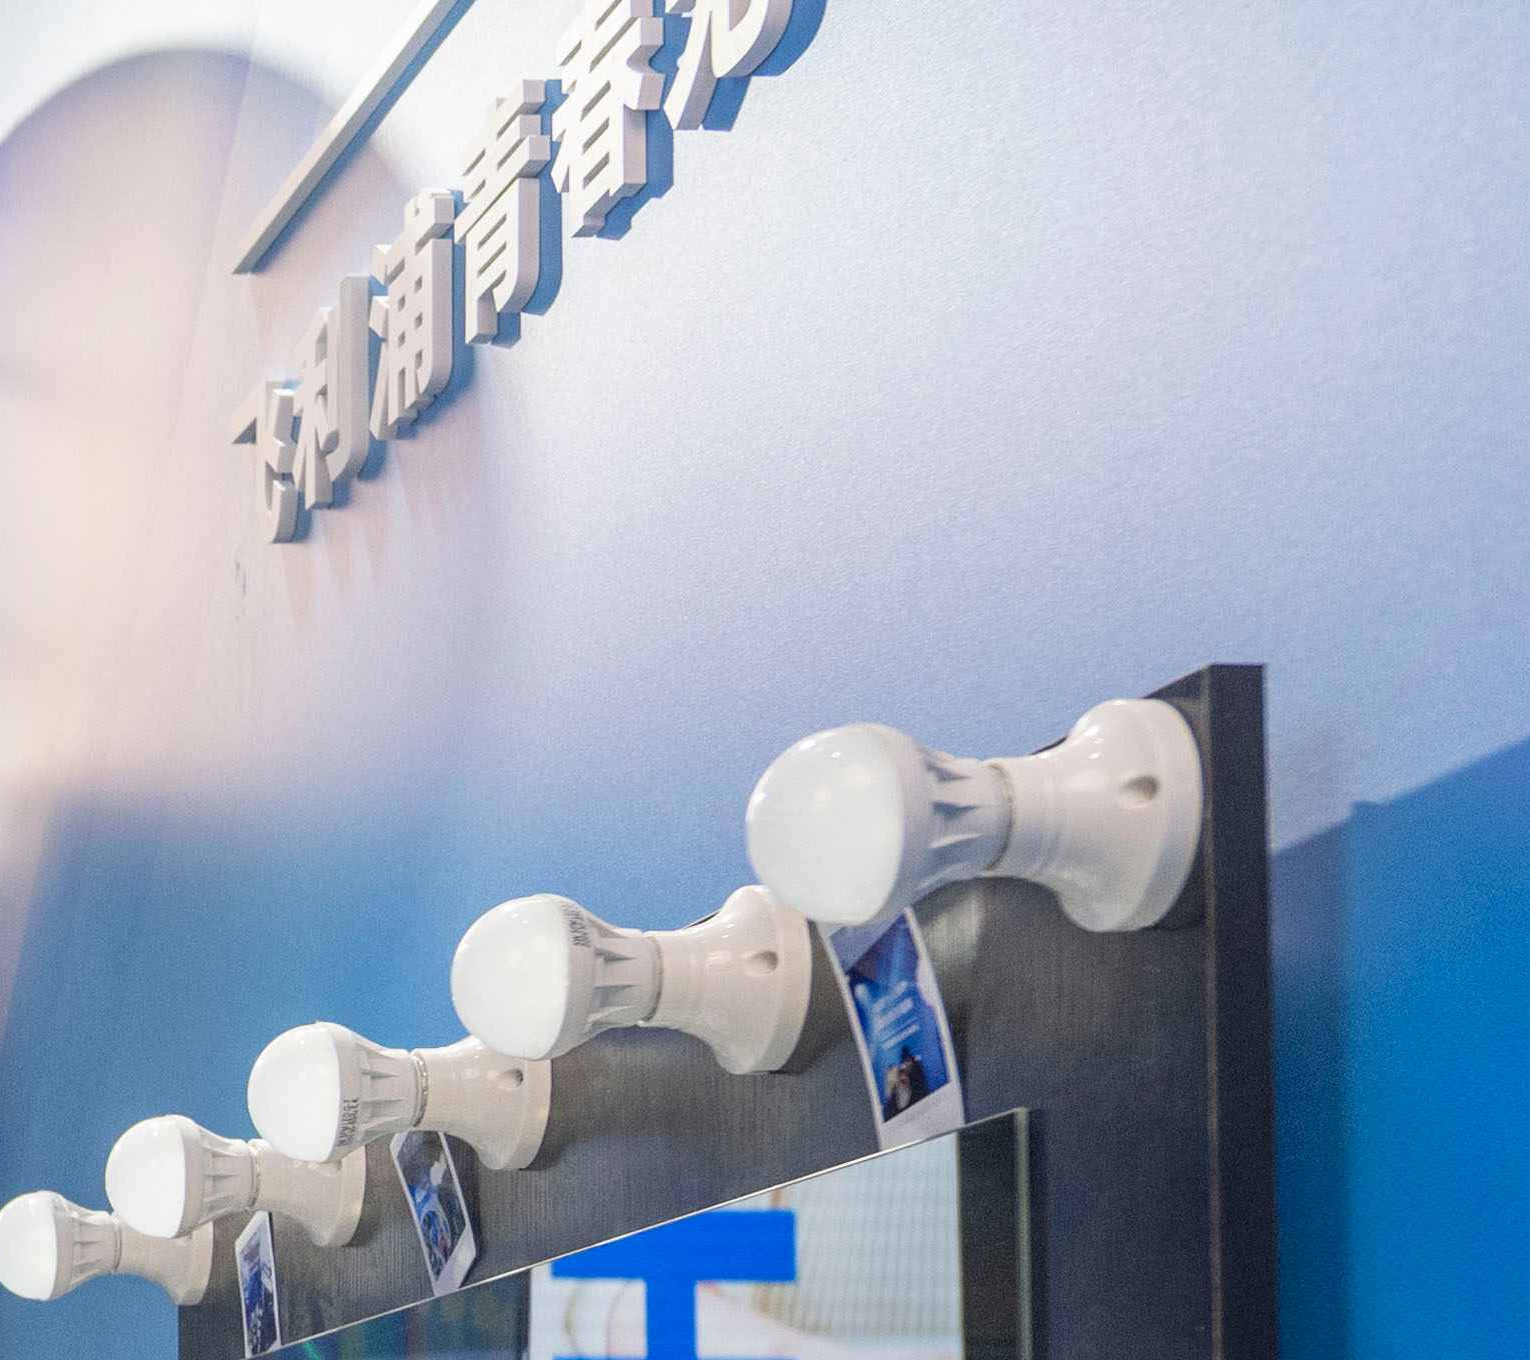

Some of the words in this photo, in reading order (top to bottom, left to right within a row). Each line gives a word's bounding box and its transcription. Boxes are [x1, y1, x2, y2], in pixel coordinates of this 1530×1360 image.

[232, 0, 797, 545] 飞利浦青春
